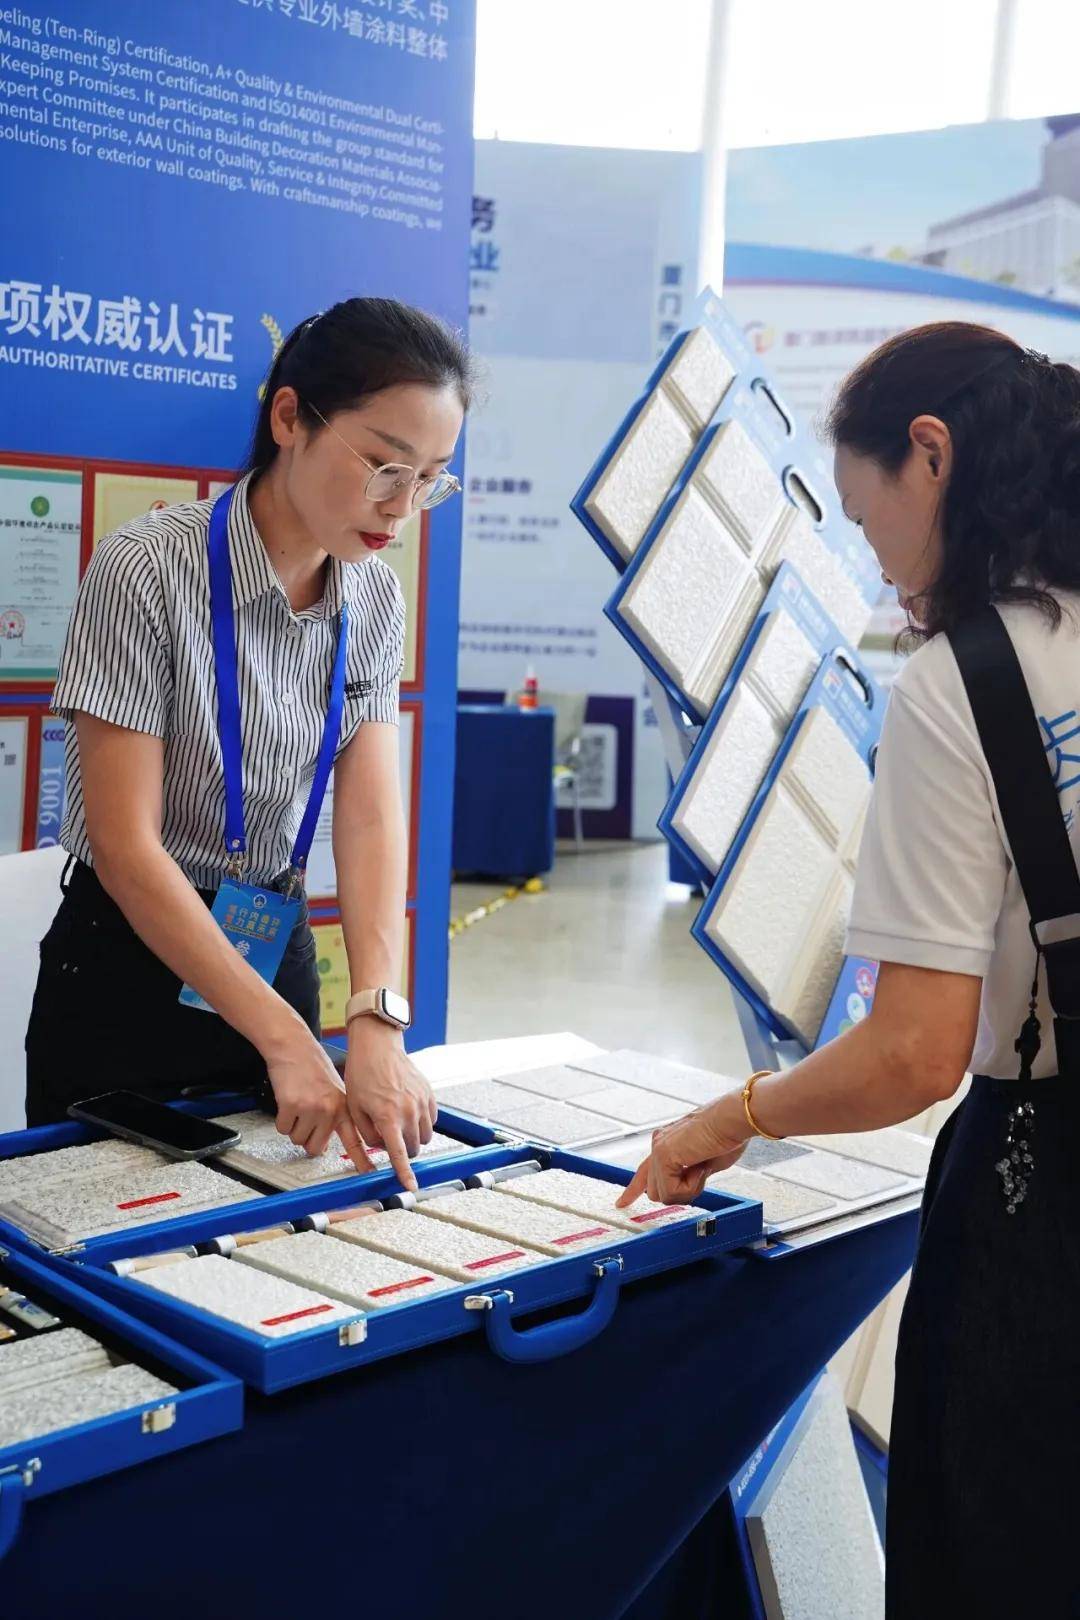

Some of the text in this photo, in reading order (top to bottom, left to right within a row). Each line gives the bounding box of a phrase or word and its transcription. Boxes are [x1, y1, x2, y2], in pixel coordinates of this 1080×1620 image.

[0, 7, 42, 36] eling
[45, 16, 121, 56] (Ten-Ring)
[124, 39, 214, 80] Certification,
[216, 64, 233, 80] A+
[235, 69, 282, 97] Quality
[284, 81, 294, 97] &
[295, 83, 385, 121] Environmental
[386, 107, 413, 128] Dual
[0, 28, 99, 69] Management
[102, 55, 153, 83] System
[156, 70, 240, 104] Certification
[242, 92, 267, 112] and
[269, 98, 327, 127] ISO14001
[329, 112, 416, 148] Environmental
[1, 53, 445, 174] Keeping Promises. It participates in drafting the group standard for
[42, 86, 126, 121] Committee
[129, 110, 170, 131] under
[173, 117, 213, 141] China
[216, 127, 270, 158] Building
[272, 140, 340, 170] Decoration
[342, 157, 396, 183] Materials
[53, 110, 133, 147] Enterprise,
[135, 130, 164, 152] AAA
[166, 136, 196, 158] Unit
[198, 144, 213, 162] of
[215, 148, 266, 177] Quality,
[267, 159, 315, 184] Service
[316, 170, 326, 187] &
[328, 172, 379, 201] Integrity
[379, 184, 445, 213] Committed
[71, 136, 94, 157] for
[97, 145, 152, 170] exterior
[156, 158, 185, 177] wall
[188, 166, 247, 192] coatings.
[250, 176, 281, 197] With
[283, 185, 370, 220] craftsmanship
[372, 205, 424, 230] coatings,
[0, 280, 234, 363] 项权威认证
[0, 346, 238, 390] AUTHORITATIVE CERTIFICATES
[40, 765, 62, 826] 9001
